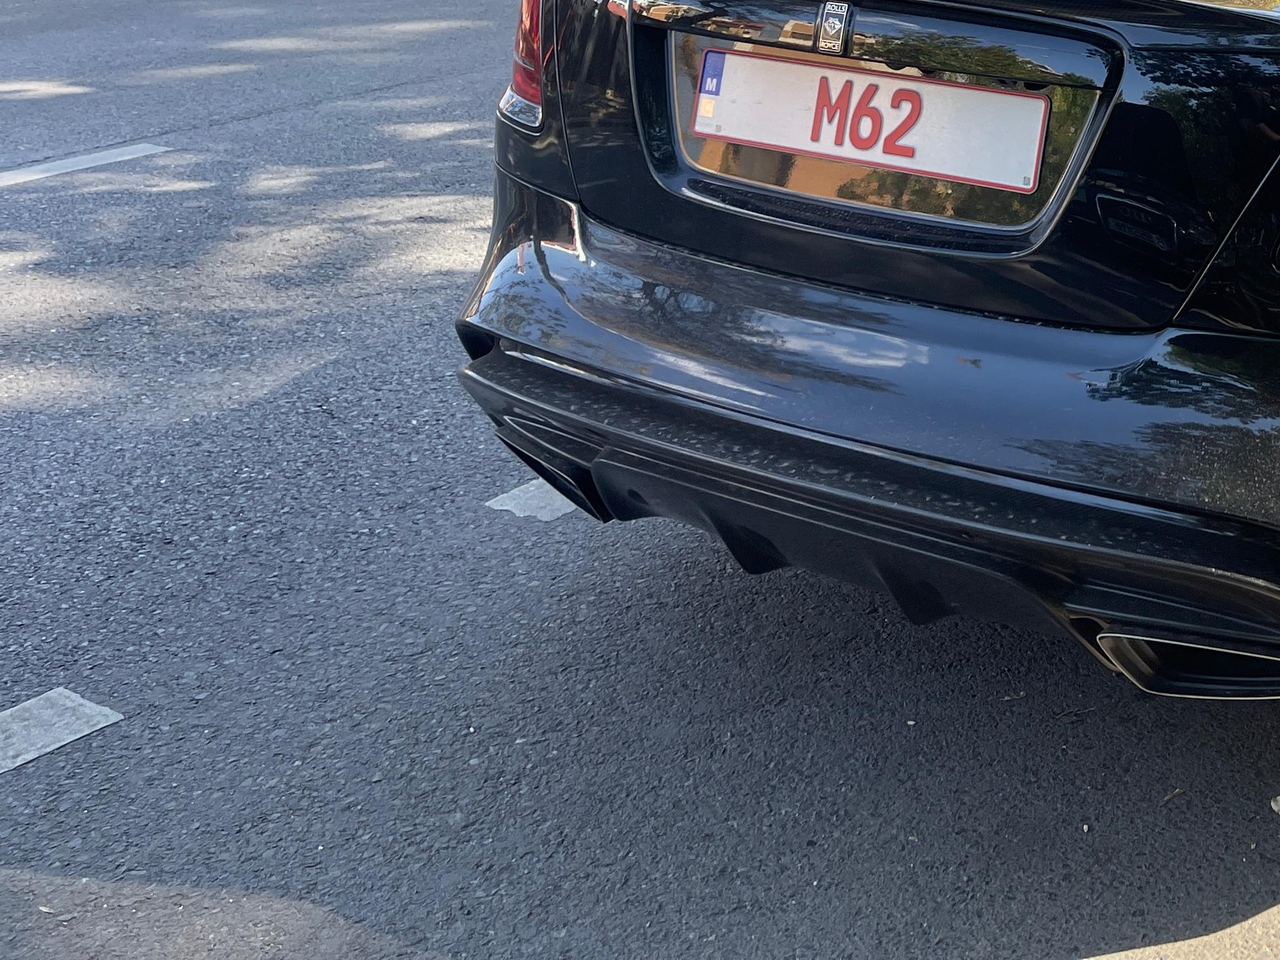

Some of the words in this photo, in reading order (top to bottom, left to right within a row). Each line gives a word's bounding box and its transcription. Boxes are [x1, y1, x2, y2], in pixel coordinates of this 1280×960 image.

[827, 4, 846, 12] ROLLS
[819, 42, 839, 50] ROYCE
[705, 77, 717, 92] M
[810, 76, 922, 159] M62
